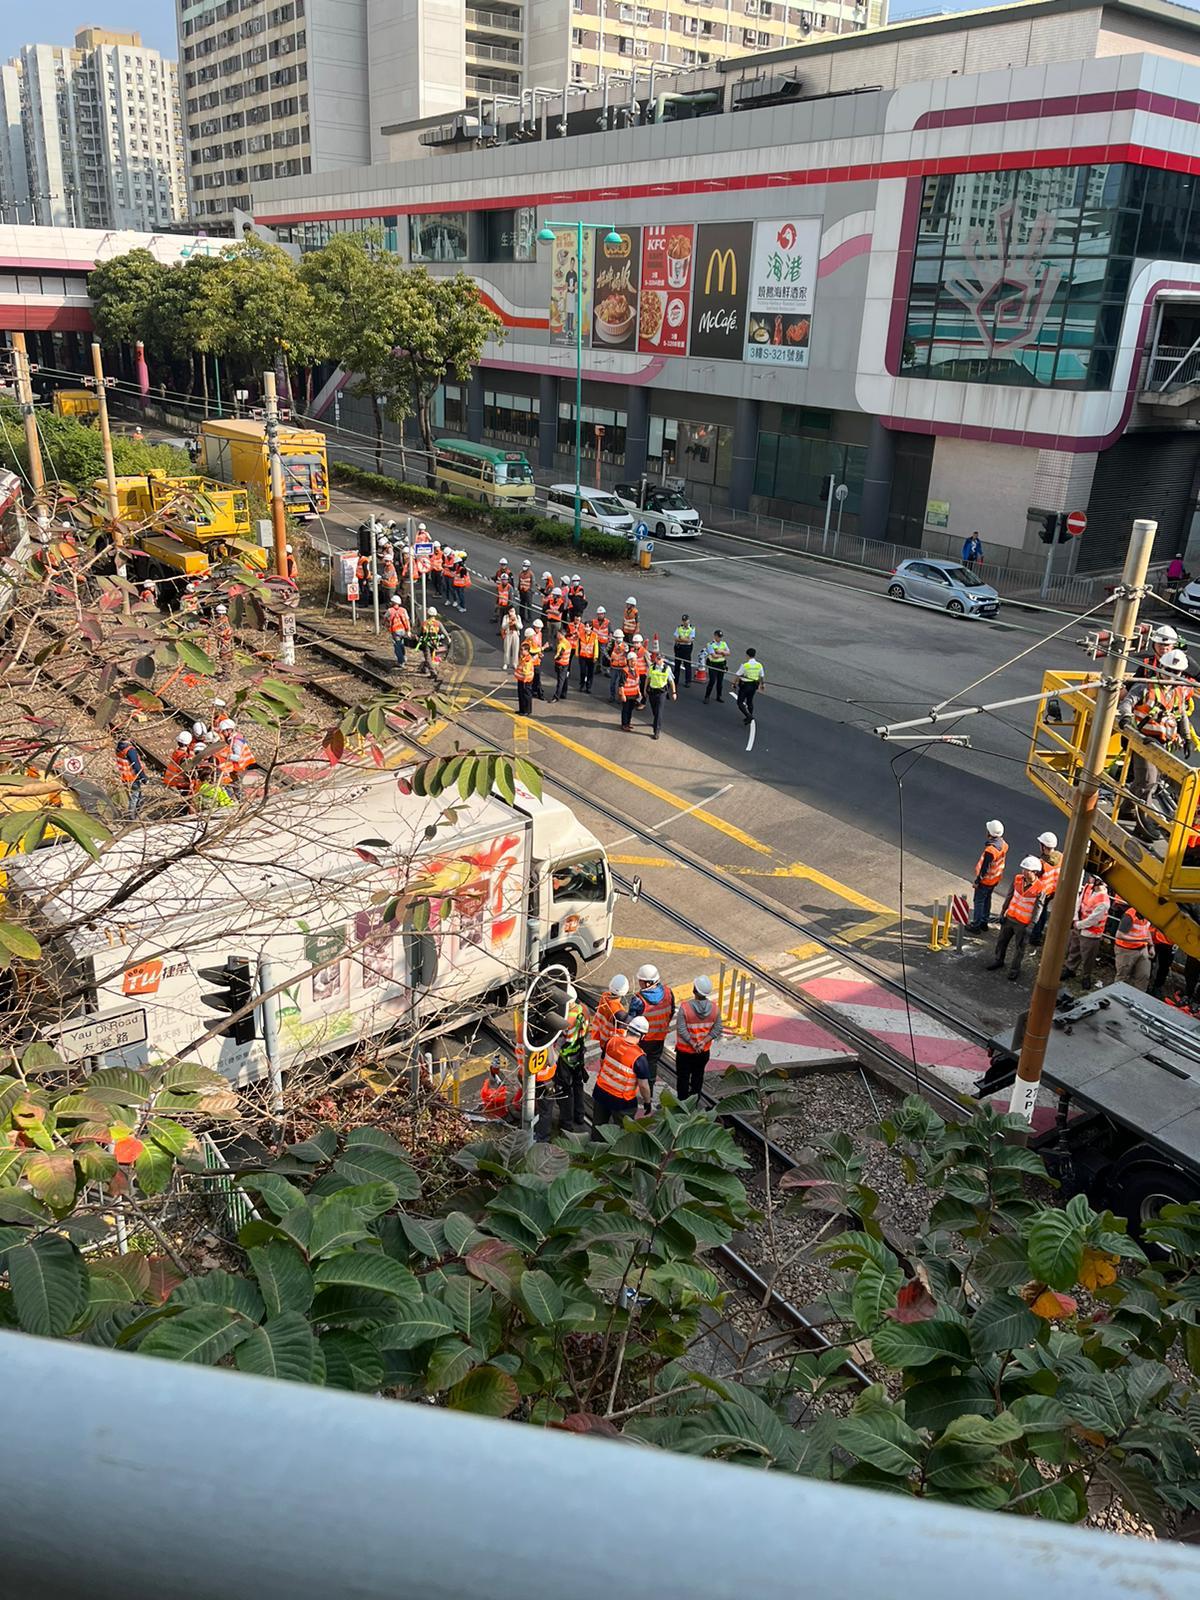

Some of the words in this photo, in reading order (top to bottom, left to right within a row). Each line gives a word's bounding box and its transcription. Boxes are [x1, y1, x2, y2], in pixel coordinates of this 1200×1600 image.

[647, 238, 667, 251] KFC
[698, 308, 737, 336] McCafé
[284, 616, 294, 625] 60
[284, 626, 295, 635] LS
[70, 1029, 92, 1042] Yau
[110, 1015, 138, 1031] Road
[532, 1049, 545, 1068] 15
[1025, 1101, 1033, 1110] P
